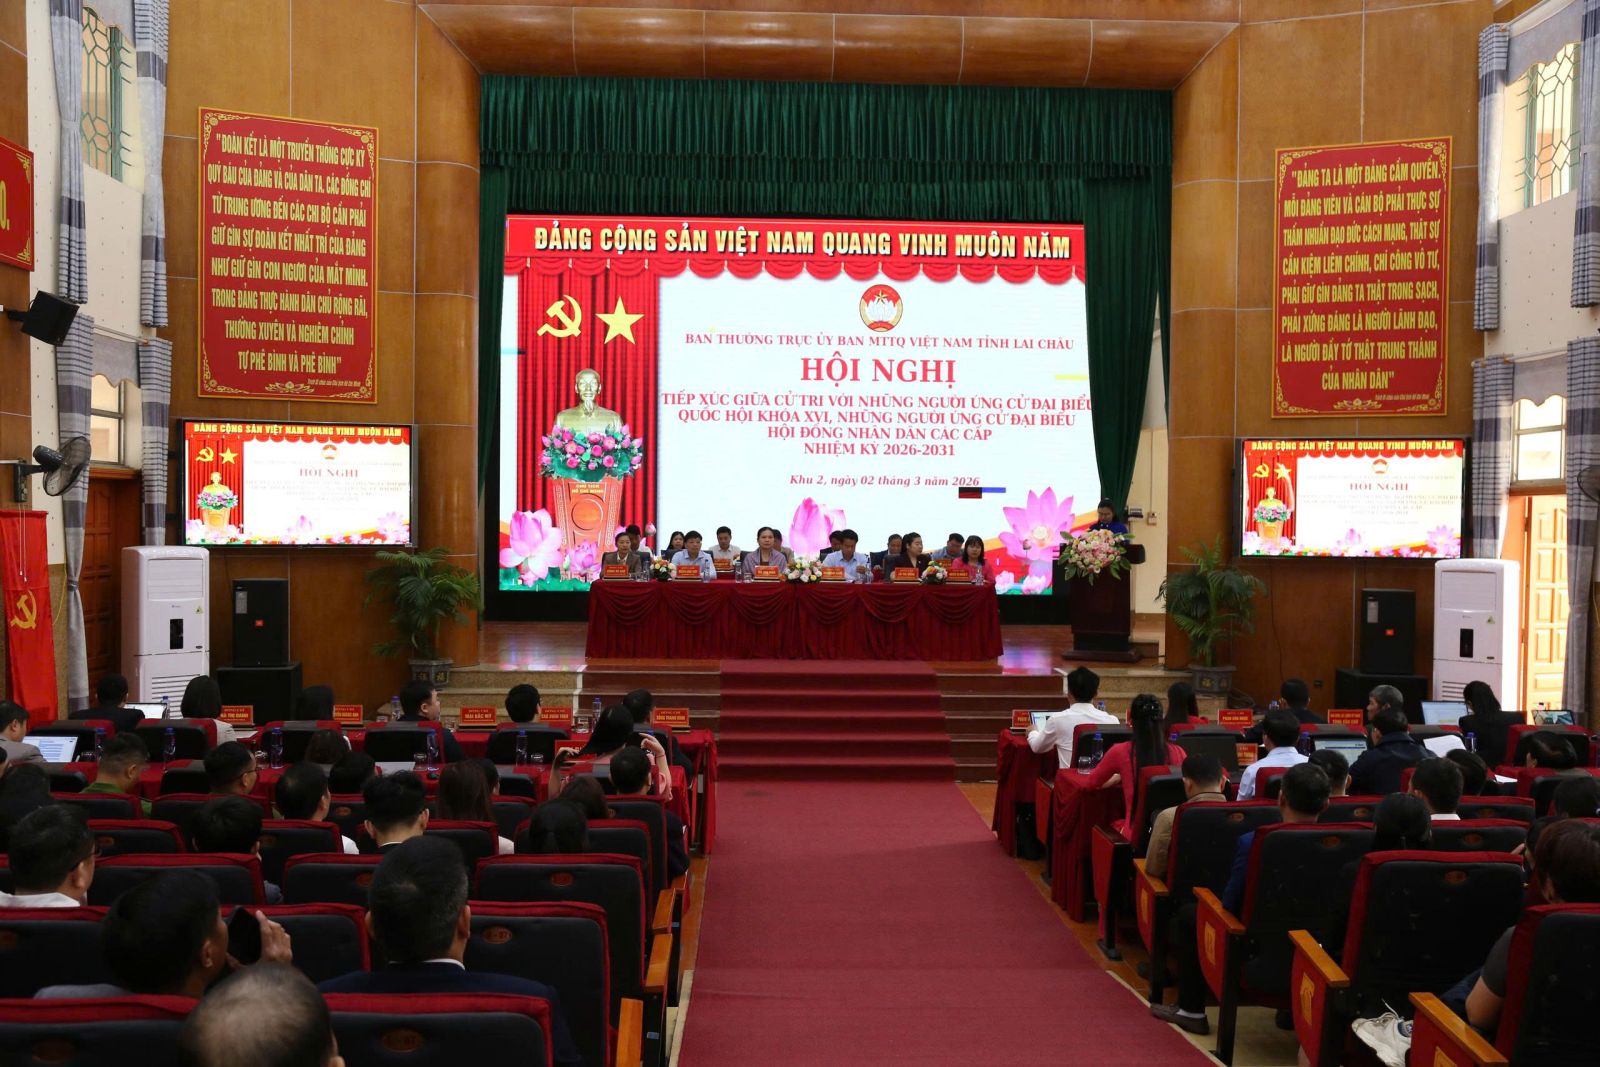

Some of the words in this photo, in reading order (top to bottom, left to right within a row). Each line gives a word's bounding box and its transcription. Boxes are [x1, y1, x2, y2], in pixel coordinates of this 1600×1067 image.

[243, 131, 257, 155] KẾT
[258, 135, 268, 156] LÀ
[269, 137, 285, 162] MỘT
[286, 140, 314, 161] TRUYỀN
[315, 140, 338, 164] THỐNG
[340, 147, 354, 169] CỰC
[207, 161, 221, 183] QUÝ
[222, 165, 236, 184] BÁU
[238, 160, 252, 185] CỦA
[253, 161, 272, 187] ĐẢNG
[273, 168, 283, 188] VÀ
[284, 165, 298, 190] CỦA
[299, 170, 313, 192] DÂN
[314, 174, 324, 193] TA.
[326, 173, 339, 194] CÁC
[340, 173, 358, 196] ĐỒNG
[359, 177, 371, 197] CHÍ
[212, 192, 222, 213] TỪ
[223, 196, 248, 216] TRUNG
[250, 198, 271, 218] ƯƠNG
[272, 195, 288, 219] ĐẾN
[289, 200, 305, 221] CÁC
[306, 204, 319, 222] CHI
[320, 202, 330, 227] BỘ
[332, 201, 347, 225] CẦN
[349, 202, 366, 226] PHẢI
[226, 224, 240, 246] GÌN
[242, 228, 253, 251] SỰ
[254, 228, 276, 249] ĐOÀN
[278, 226, 292, 250] KẾT
[294, 228, 314, 252] NHẤT
[315, 232, 327, 253] TRÍ
[328, 229, 344, 254] CỦA
[345, 231, 366, 256] ĐẢNG
[534, 220, 592, 250] ĐẢNG
[600, 224, 656, 254] CỘNG
[664, 222, 707, 251] SẢN
[714, 226, 759, 256] VIỆT
[766, 231, 814, 253] NAM
[822, 232, 890, 255] QUANG
[898, 233, 947, 256] VINH
[954, 231, 1016, 257] MUÔN
[1023, 232, 1070, 258] NĂM
[1282, 252, 1299, 275] CẦN
[1300, 253, 1321, 277] KIỆM
[1323, 252, 1342, 273] LIÊM
[1344, 252, 1371, 272] CHÍNH,
[1373, 250, 1387, 271] CHÍ
[1389, 249, 1412, 270] CÔNG
[1414, 248, 1425, 269] VÔ
[1427, 250, 1439, 269] TƯ,
[1281, 279, 1300, 304] PHẢI
[1316, 282, 1330, 303] GÌN
[1331, 278, 1353, 302] ĐẢNG
[1354, 283, 1364, 301] TA
[1366, 279, 1385, 303] THẬT
[1387, 282, 1413, 299] TRONG
[1415, 281, 1439, 302] SẠCH,
[1281, 308, 1301, 332] PHẢI
[1302, 311, 1325, 332] XỨNG
[1327, 311, 1350, 331] ĐÁNG
[1352, 310, 1363, 330] LÀ
[1393, 308, 1415, 329] LÃNH
[1417, 311, 1437, 331] ĐẠO,
[685, 334, 712, 344] BAN
[777, 335, 812, 348] TRỰC
[817, 333, 834, 346] ỦY
[837, 336, 864, 346] BAN
[868, 337, 906, 348] MTTQ
[910, 335, 940, 350] VIỆT
[943, 338, 972, 348] NAM
[977, 336, 1009, 349] TỈNH
[1013, 339, 1034, 349] LAI
[1038, 337, 1074, 350] CHÂU
[1281, 341, 1292, 362] LÀ
[1341, 338, 1352, 360] TỚ
[1353, 339, 1375, 362] THẬT
[1376, 341, 1405, 359] TRUNG
[1407, 338, 1436, 358] THÀNH
[801, 352, 860, 386] HỘI
[872, 359, 955, 388] NGHỊ
[1321, 366, 1339, 390] CỦA
[1341, 368, 1367, 389] NHÂN
[661, 389, 695, 406] TIẾP
[699, 392, 730, 406] XÚC
[733, 392, 770, 406] GIỮA
[774, 391, 799, 407] CỬ
[801, 395, 823, 407] TRI
[828, 394, 854, 408] VỚI
[971, 396, 1002, 410] ỨNG
[1006, 394, 1030, 410] CỬ
[1031, 399, 1056, 413] ĐẠI
[678, 406, 720, 423] QUỐC
[725, 408, 752, 425] HỘI
[758, 409, 800, 423] KHÓA
[804, 411, 832, 425] XVI,
[950, 411, 982, 425] ỨNG
[985, 410, 1009, 426] CỬ
[1010, 414, 1035, 428] ĐẠI
[1040, 411, 1076, 426] BIỂU
[768, 425, 794, 441] HỘI
[800, 423, 843, 439] ĐỒNG
[848, 426, 890, 440] NHÂN
[896, 426, 925, 440] DÂN
[930, 427, 959, 440] CÁC
[804, 441, 854, 457] NHIỆM
[860, 441, 878, 455] KỲ
[883, 444, 953, 456] 2026-2031
[790, 474, 812, 484] Khu
[816, 475, 826, 484] 2,
[830, 477, 856, 486] ngày
[860, 475, 874, 484] 02
[878, 475, 910, 486] tháng
[914, 476, 920, 485] 3
[951, 477, 979, 486] 2026
